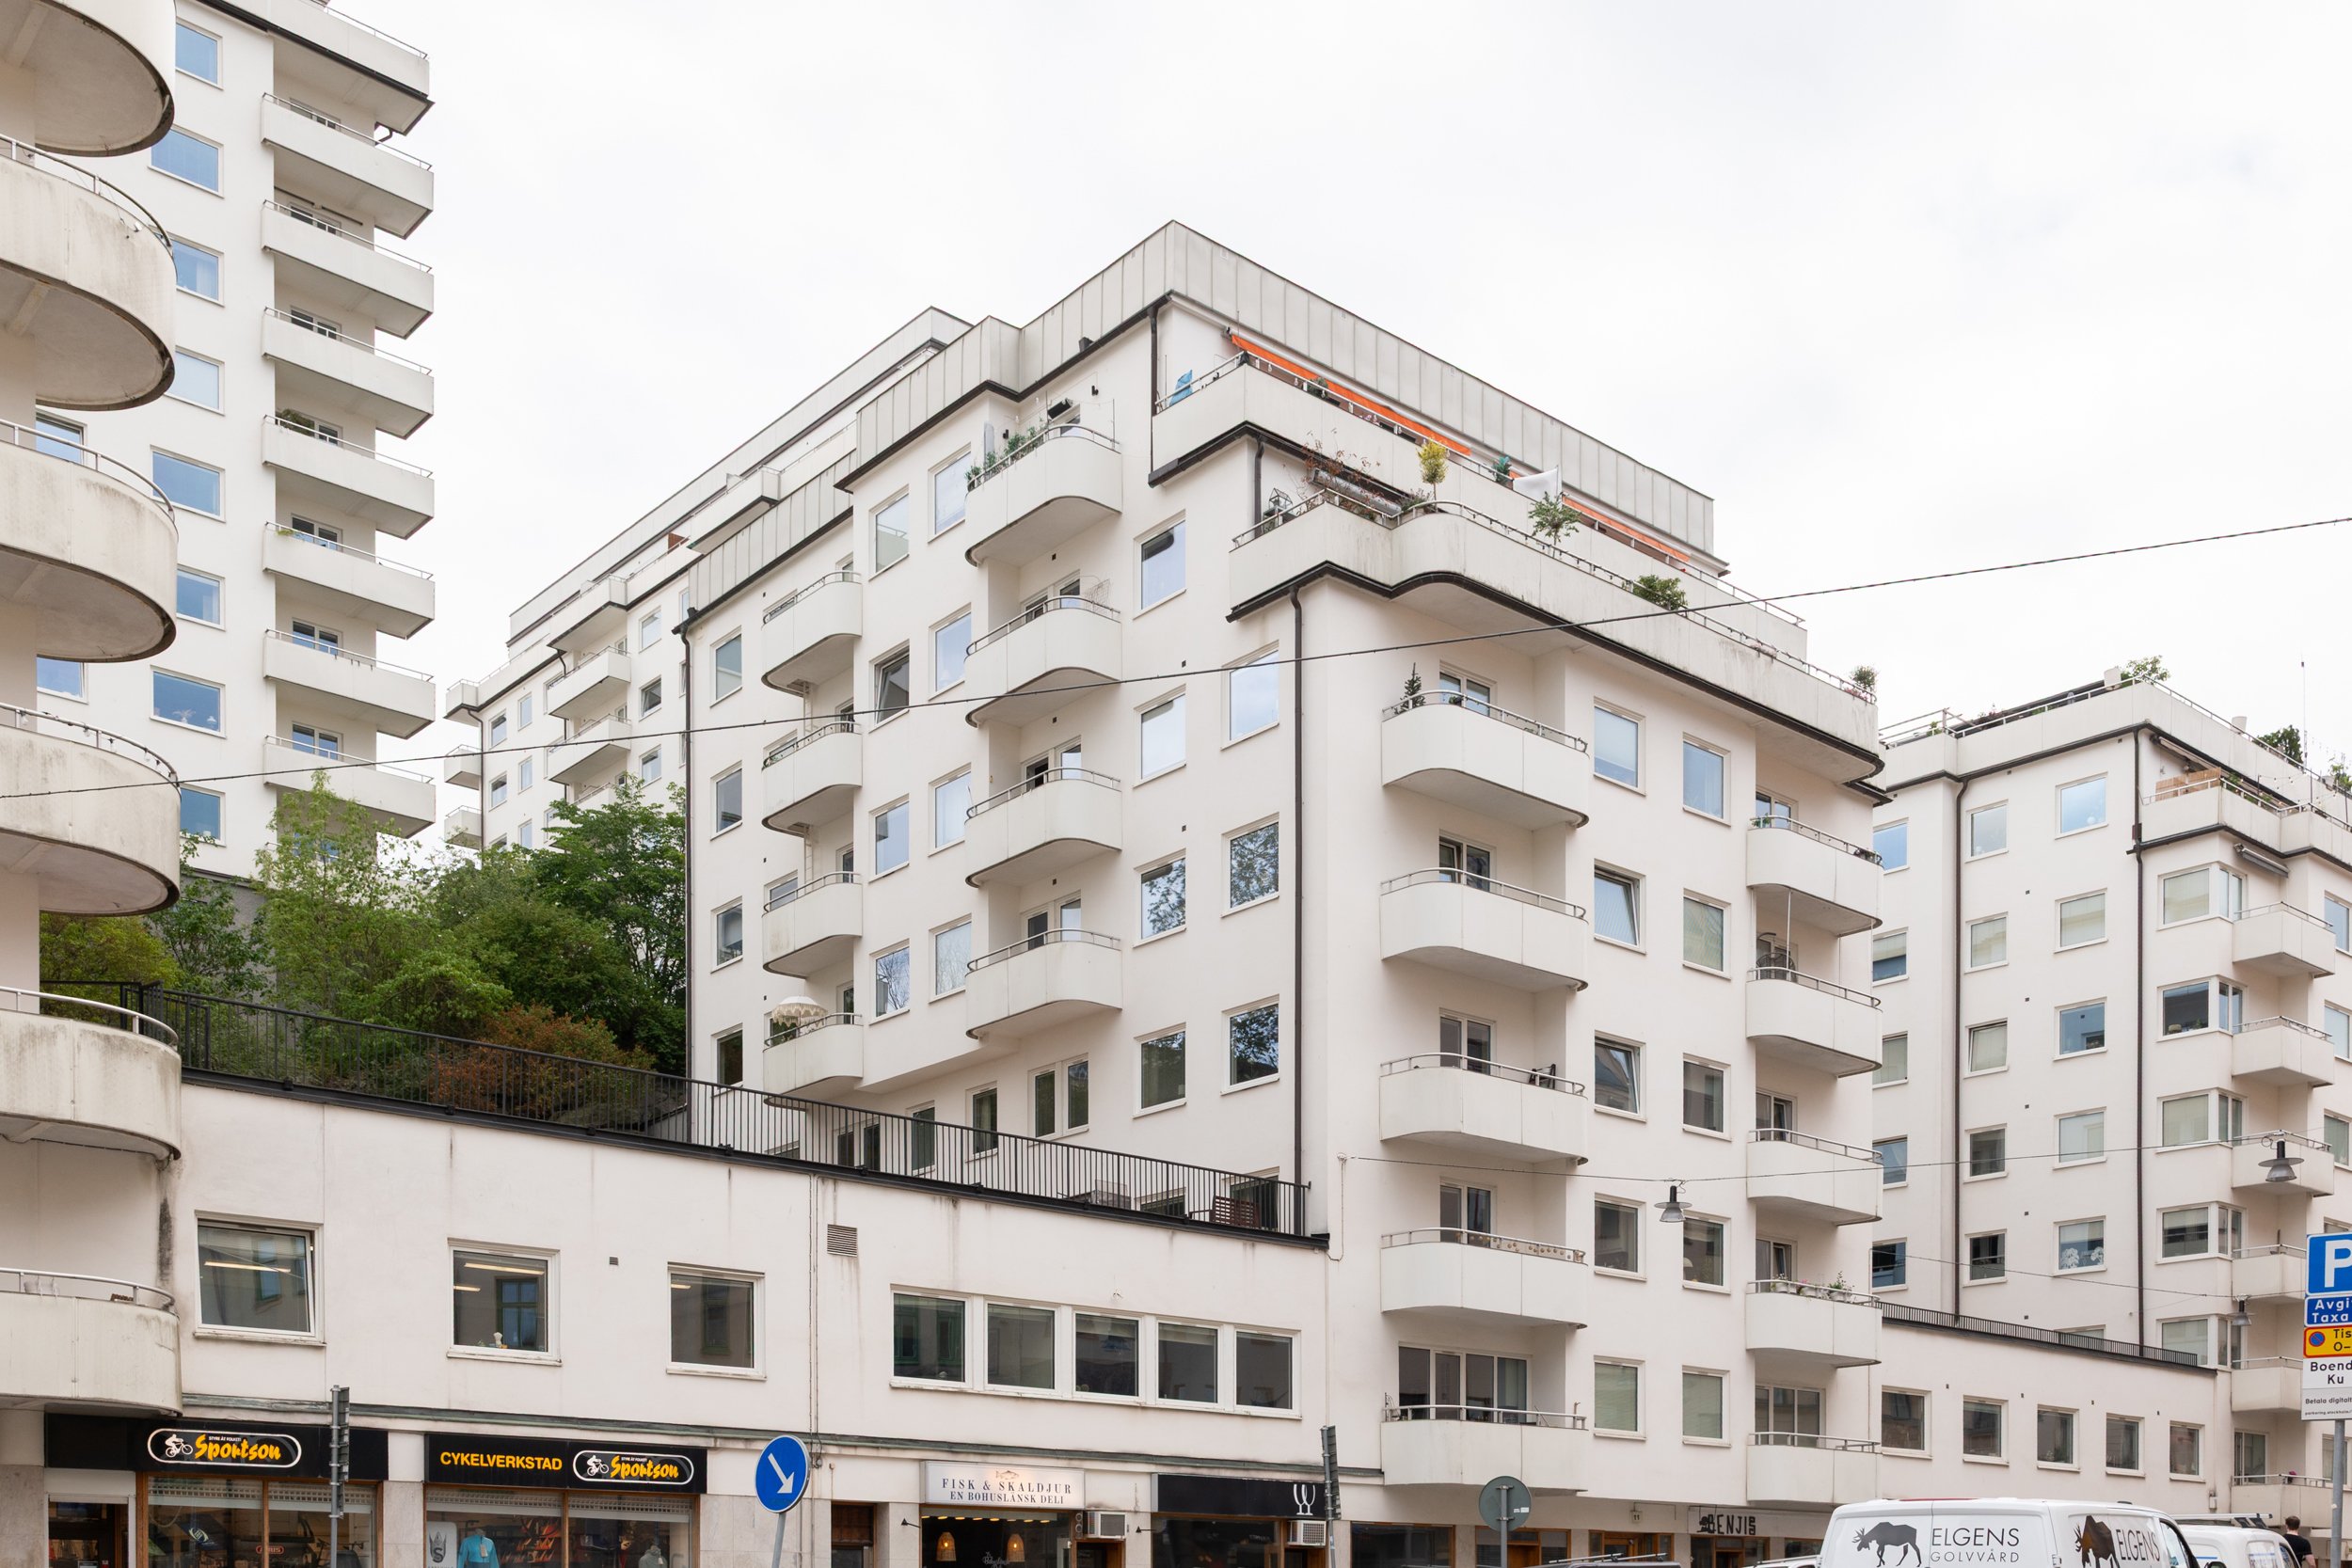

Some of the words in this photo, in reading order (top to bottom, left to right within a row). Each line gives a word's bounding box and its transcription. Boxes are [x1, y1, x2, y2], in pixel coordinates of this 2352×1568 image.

[2324, 1239, 2352, 1288] P
[2314, 1297, 2352, 1311] Avgi
[2312, 1312, 2349, 1323] Taxa
[2333, 1328, 2352, 1338] Tis
[2327, 1374, 2344, 1385] Ku
[195, 1434, 281, 1461] Sportson
[440, 1451, 563, 1470] CYKELVERKSTAD
[611, 1455, 679, 1480] Sportson
[943, 1478, 976, 1491] FISK
[982, 1481, 991, 1491] &
[998, 1481, 1072, 1495] SKALDJUR
[950, 1491, 963, 1500] EN
[968, 1492, 1036, 1503] BOHUSLÄNSK
[1041, 1495, 1064, 1505] DELI
[1708, 1513, 1756, 1536] BENJIS
[1931, 1528, 2020, 1547] ELGENS
[2116, 1529, 2161, 1561] ELGENS
[1931, 1548, 2019, 1563] GOLVVÅRD
